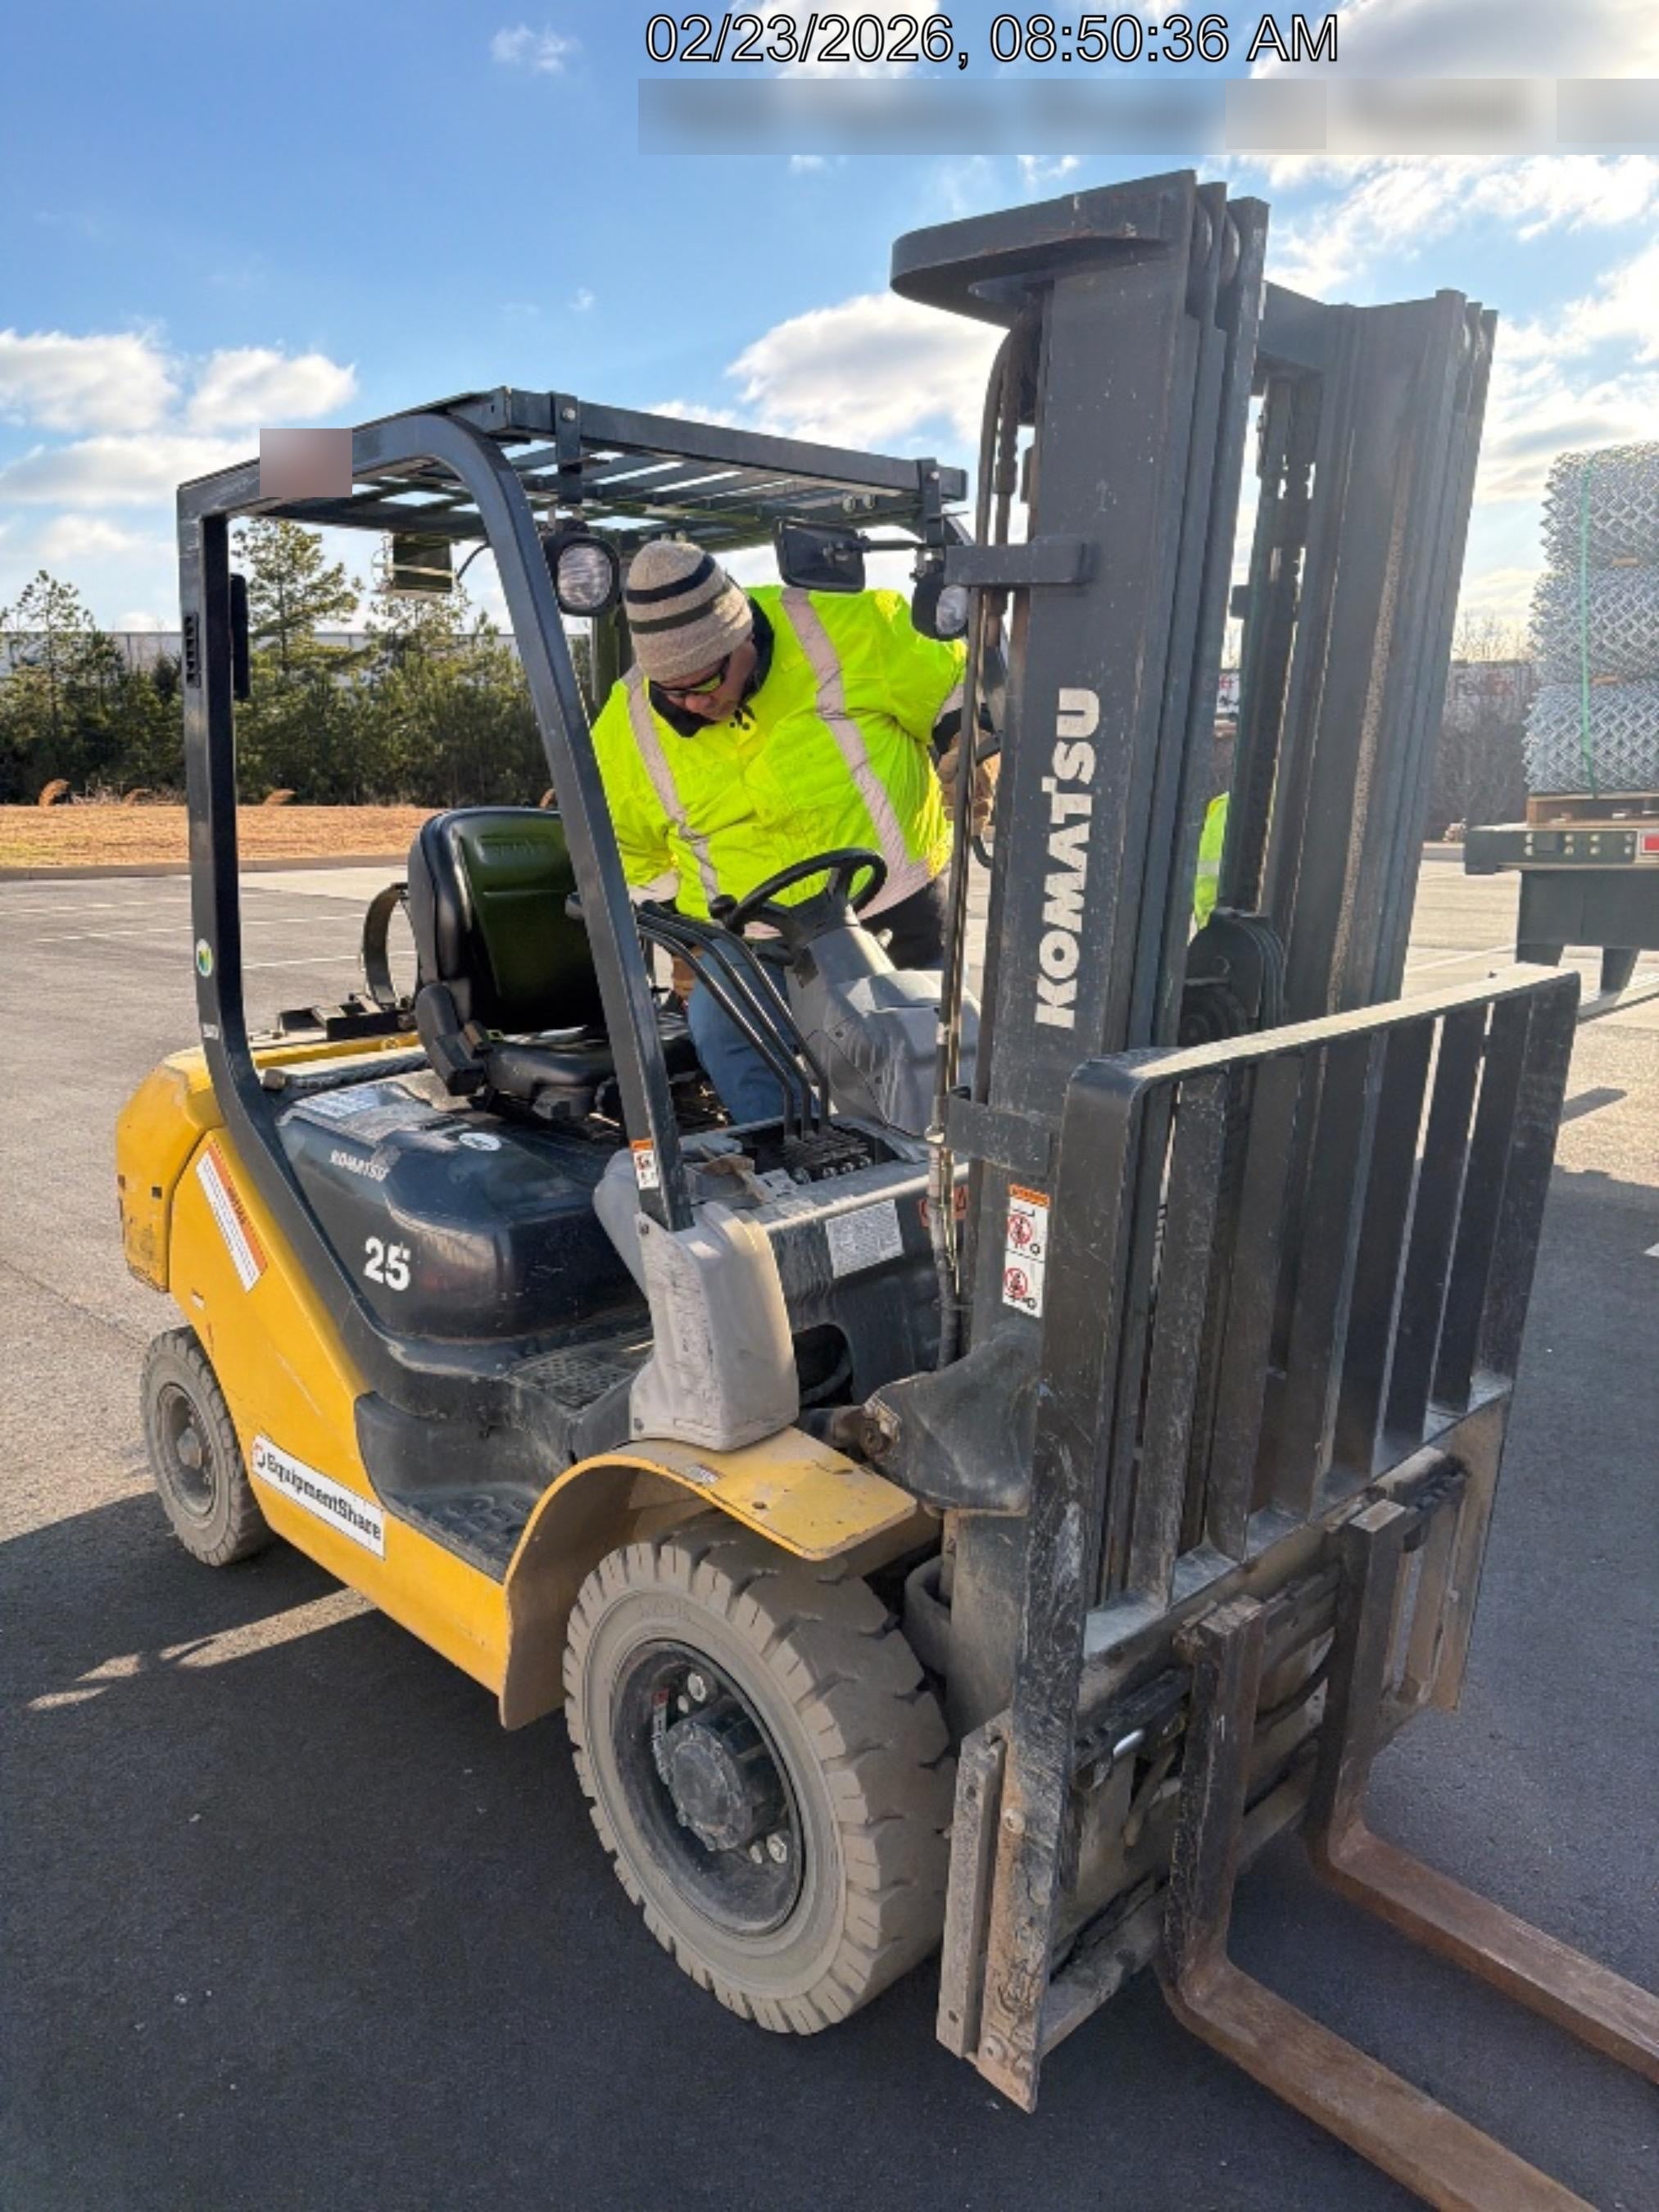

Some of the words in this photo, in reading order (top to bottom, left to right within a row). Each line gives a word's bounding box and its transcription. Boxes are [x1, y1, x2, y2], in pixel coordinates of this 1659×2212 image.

[1035, 687, 1099, 1029] KOMATSU
[329, 1149, 391, 1182] KOMATSU
[363, 1235, 411, 1292] 25
[267, 1451, 382, 1542] EquipmentShare
